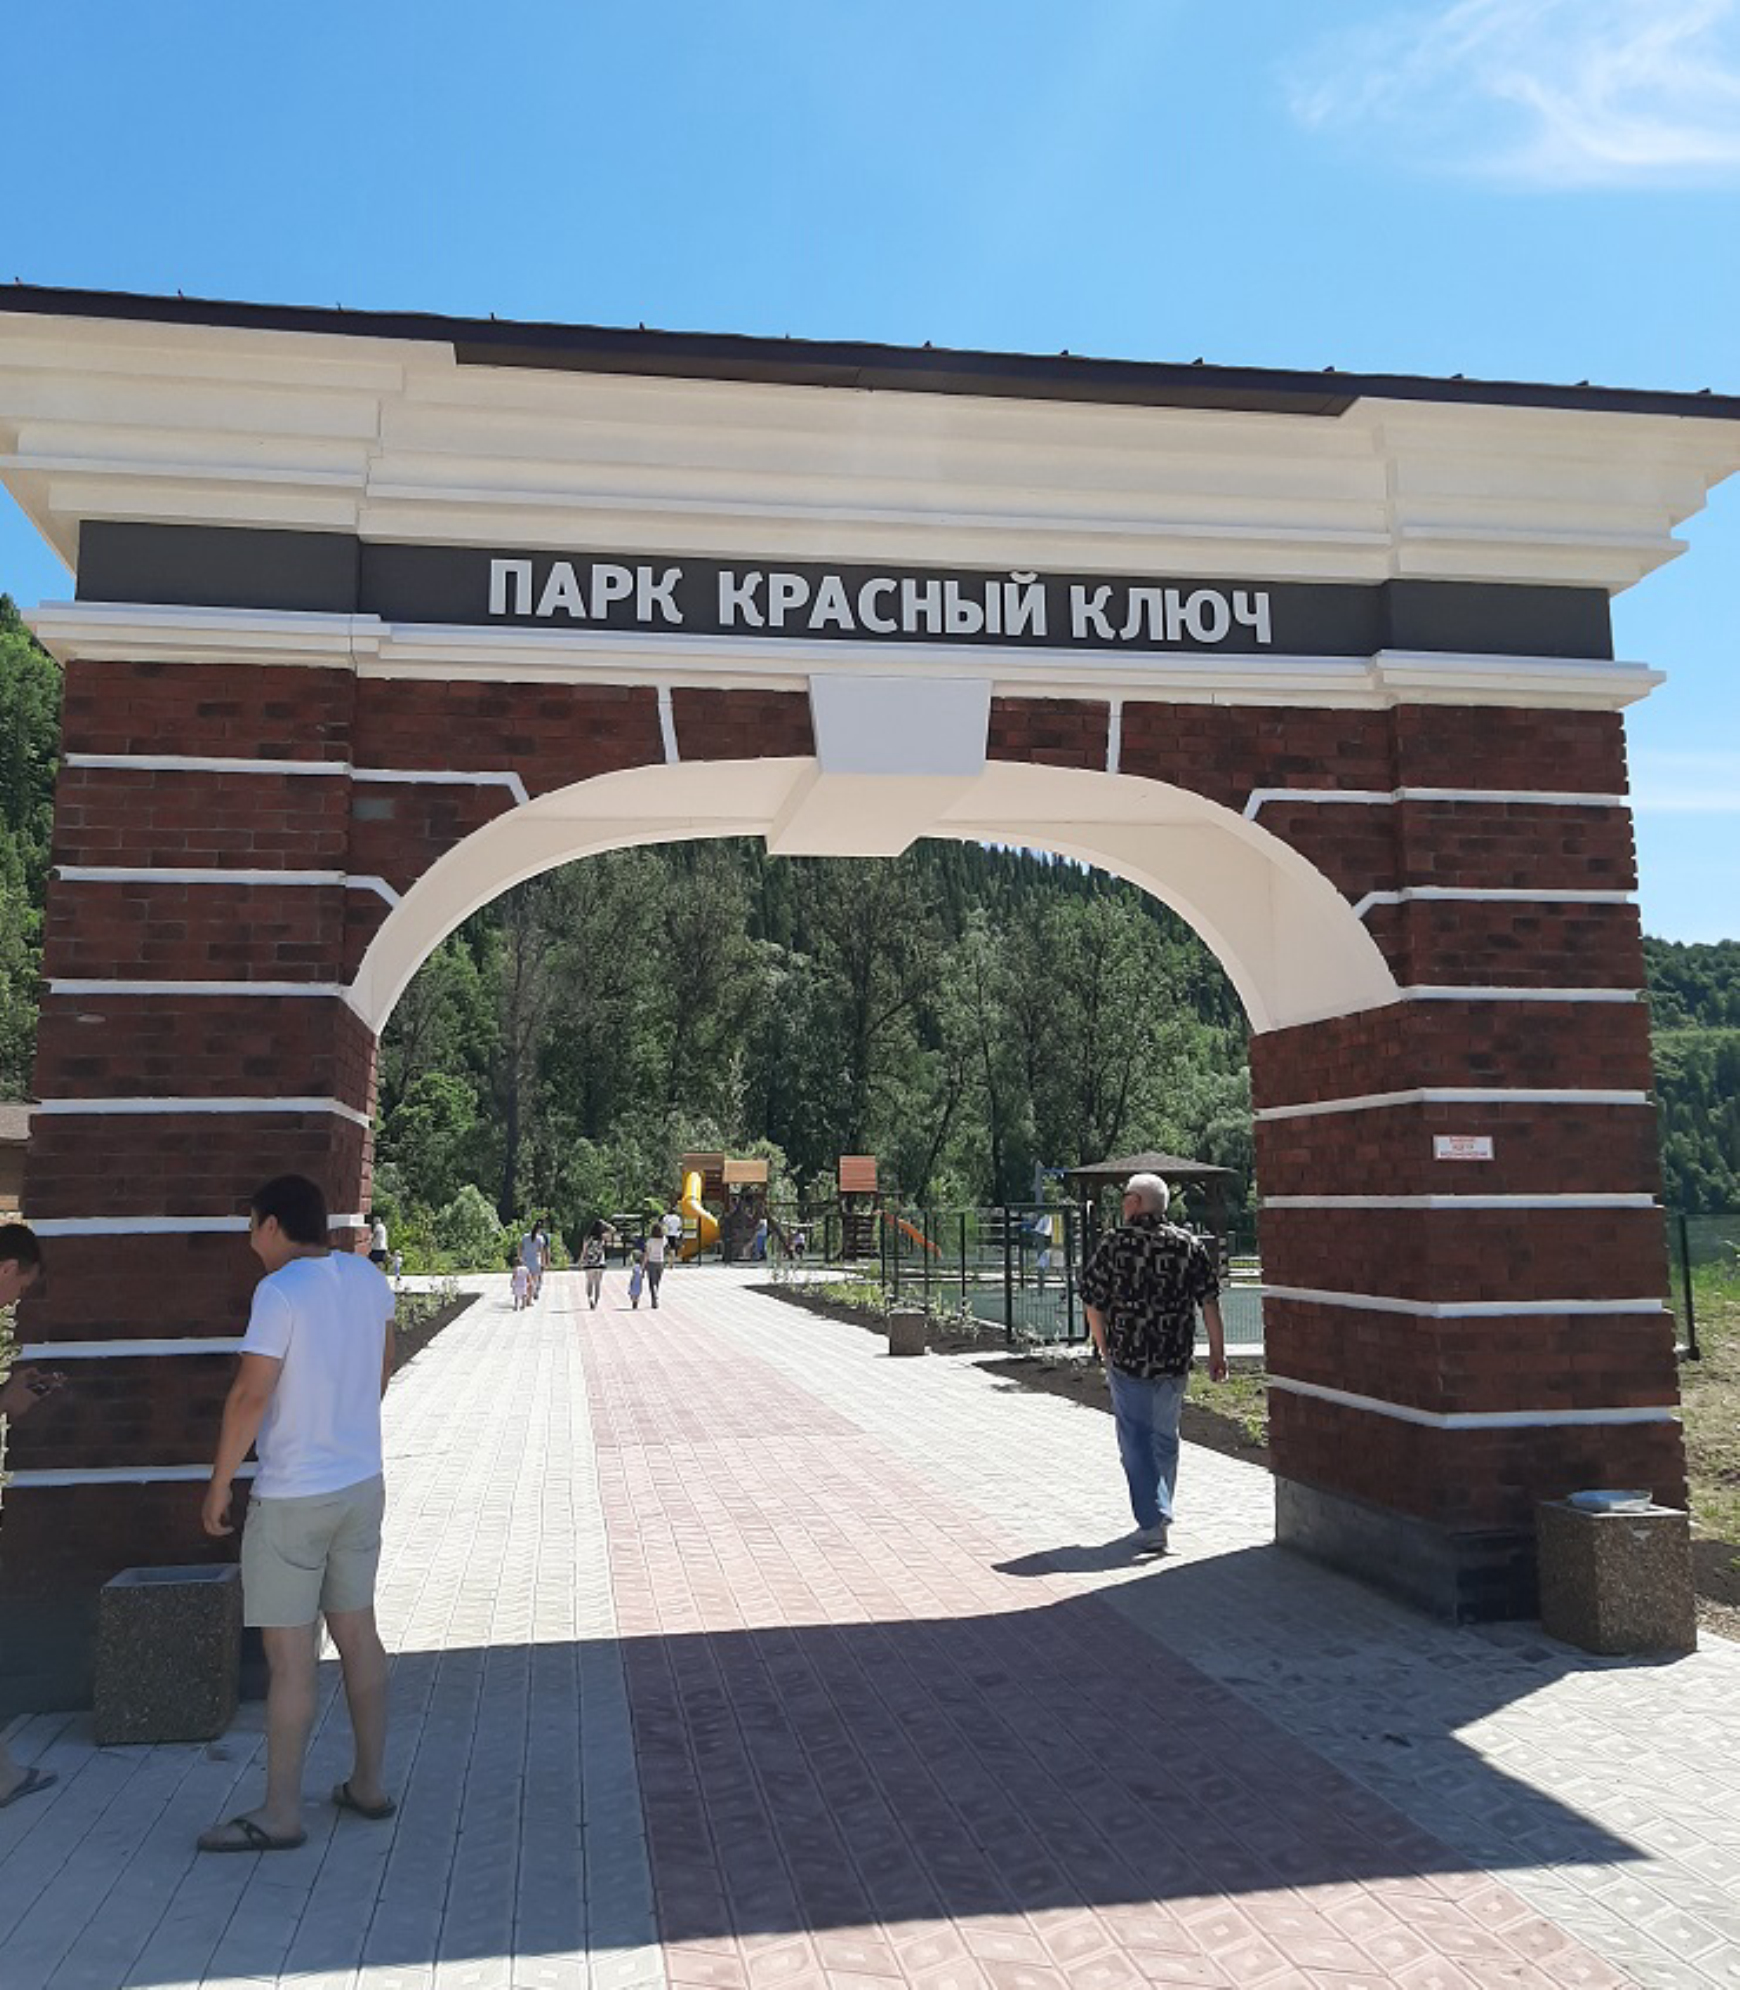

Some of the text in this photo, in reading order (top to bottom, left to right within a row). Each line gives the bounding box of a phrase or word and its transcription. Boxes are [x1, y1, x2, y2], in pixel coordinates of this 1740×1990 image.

[489, 559, 1271, 644] ПАРК КРАСНЫЙ КЛЮЧ
